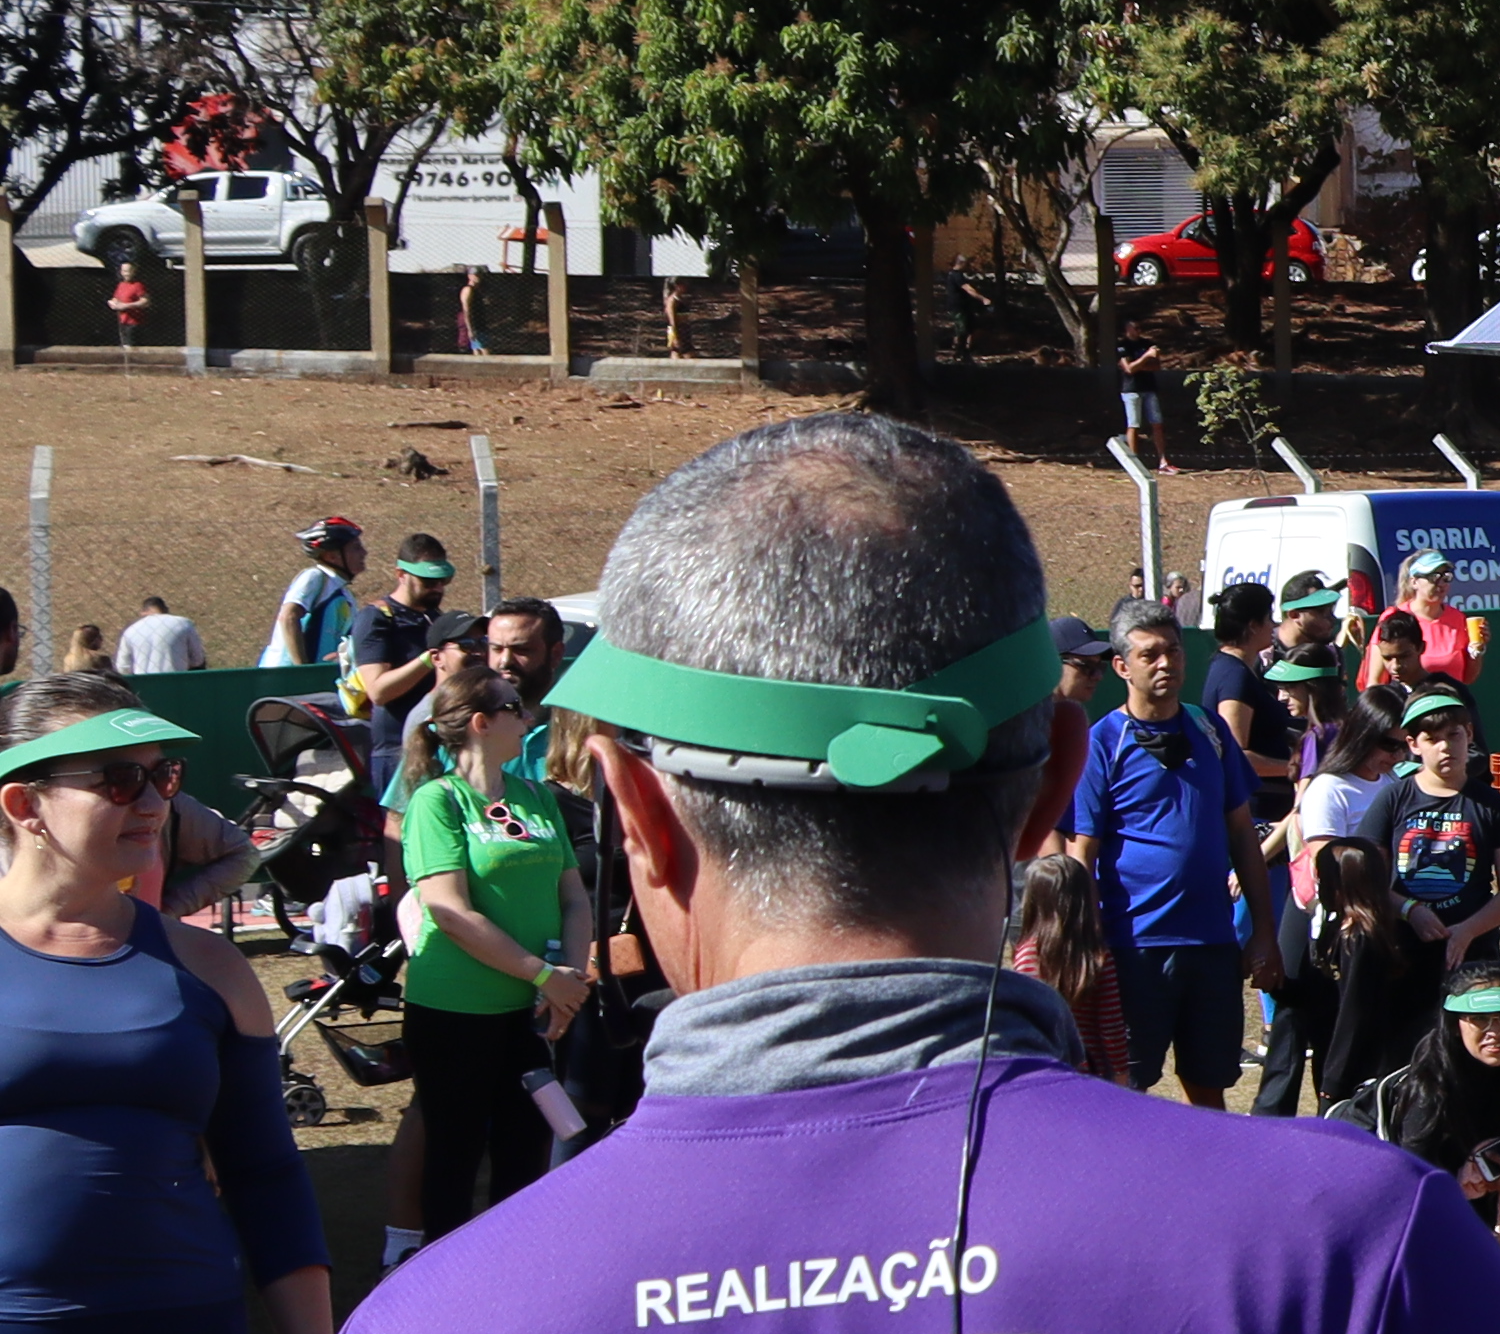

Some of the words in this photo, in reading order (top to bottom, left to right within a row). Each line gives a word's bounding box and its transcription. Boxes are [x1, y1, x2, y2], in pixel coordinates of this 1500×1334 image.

[1396, 527, 1497, 553] SORRIA,
[1433, 821, 1472, 832] GAME
[636, 1236, 999, 1328] REALIZAÇÃO
